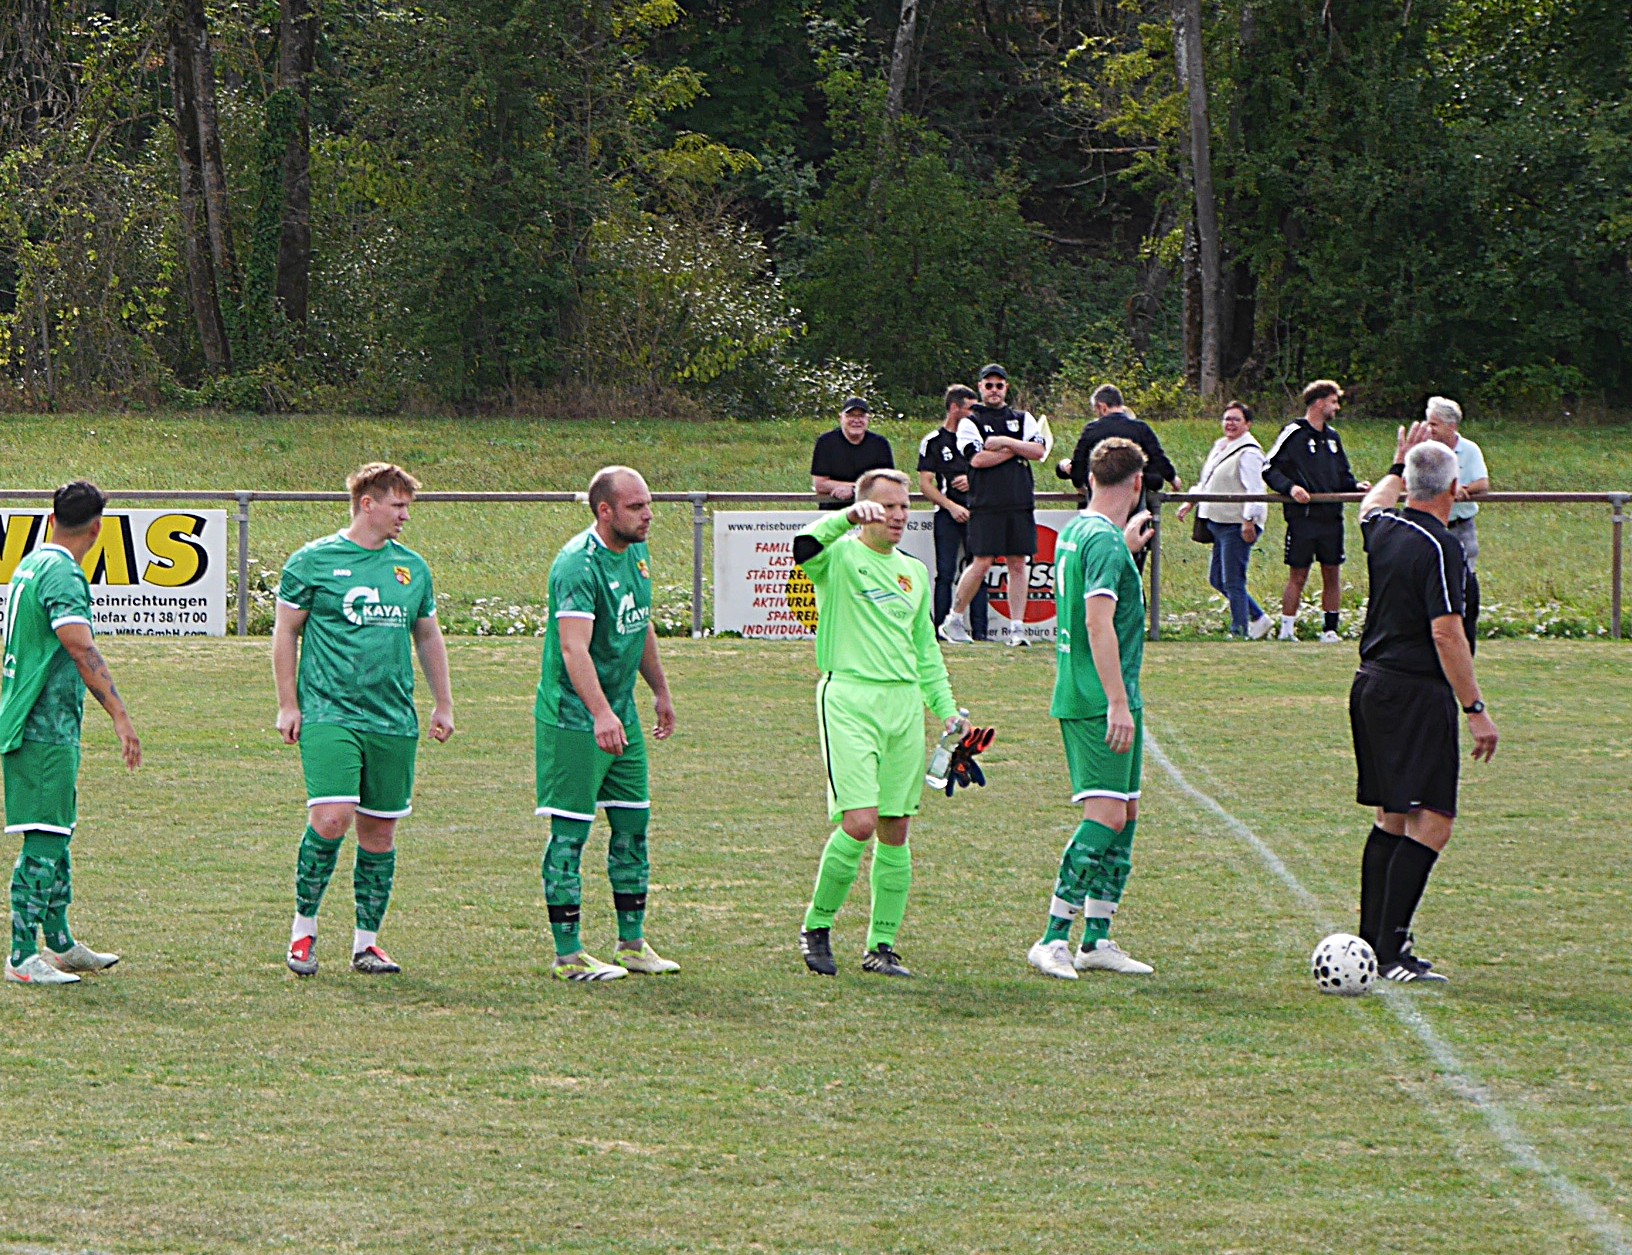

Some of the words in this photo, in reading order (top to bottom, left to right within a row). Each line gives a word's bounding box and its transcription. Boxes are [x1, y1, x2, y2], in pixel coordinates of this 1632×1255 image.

[755, 542, 791, 553] FAMIL
[746, 567, 807, 580] STÄDTEREI
[90, 594, 207, 609] seinrichtungen
[752, 597, 816, 608] AKTIVURLA
[363, 605, 402, 618] KAYA
[742, 623, 818, 636] INDIVIDUALR
